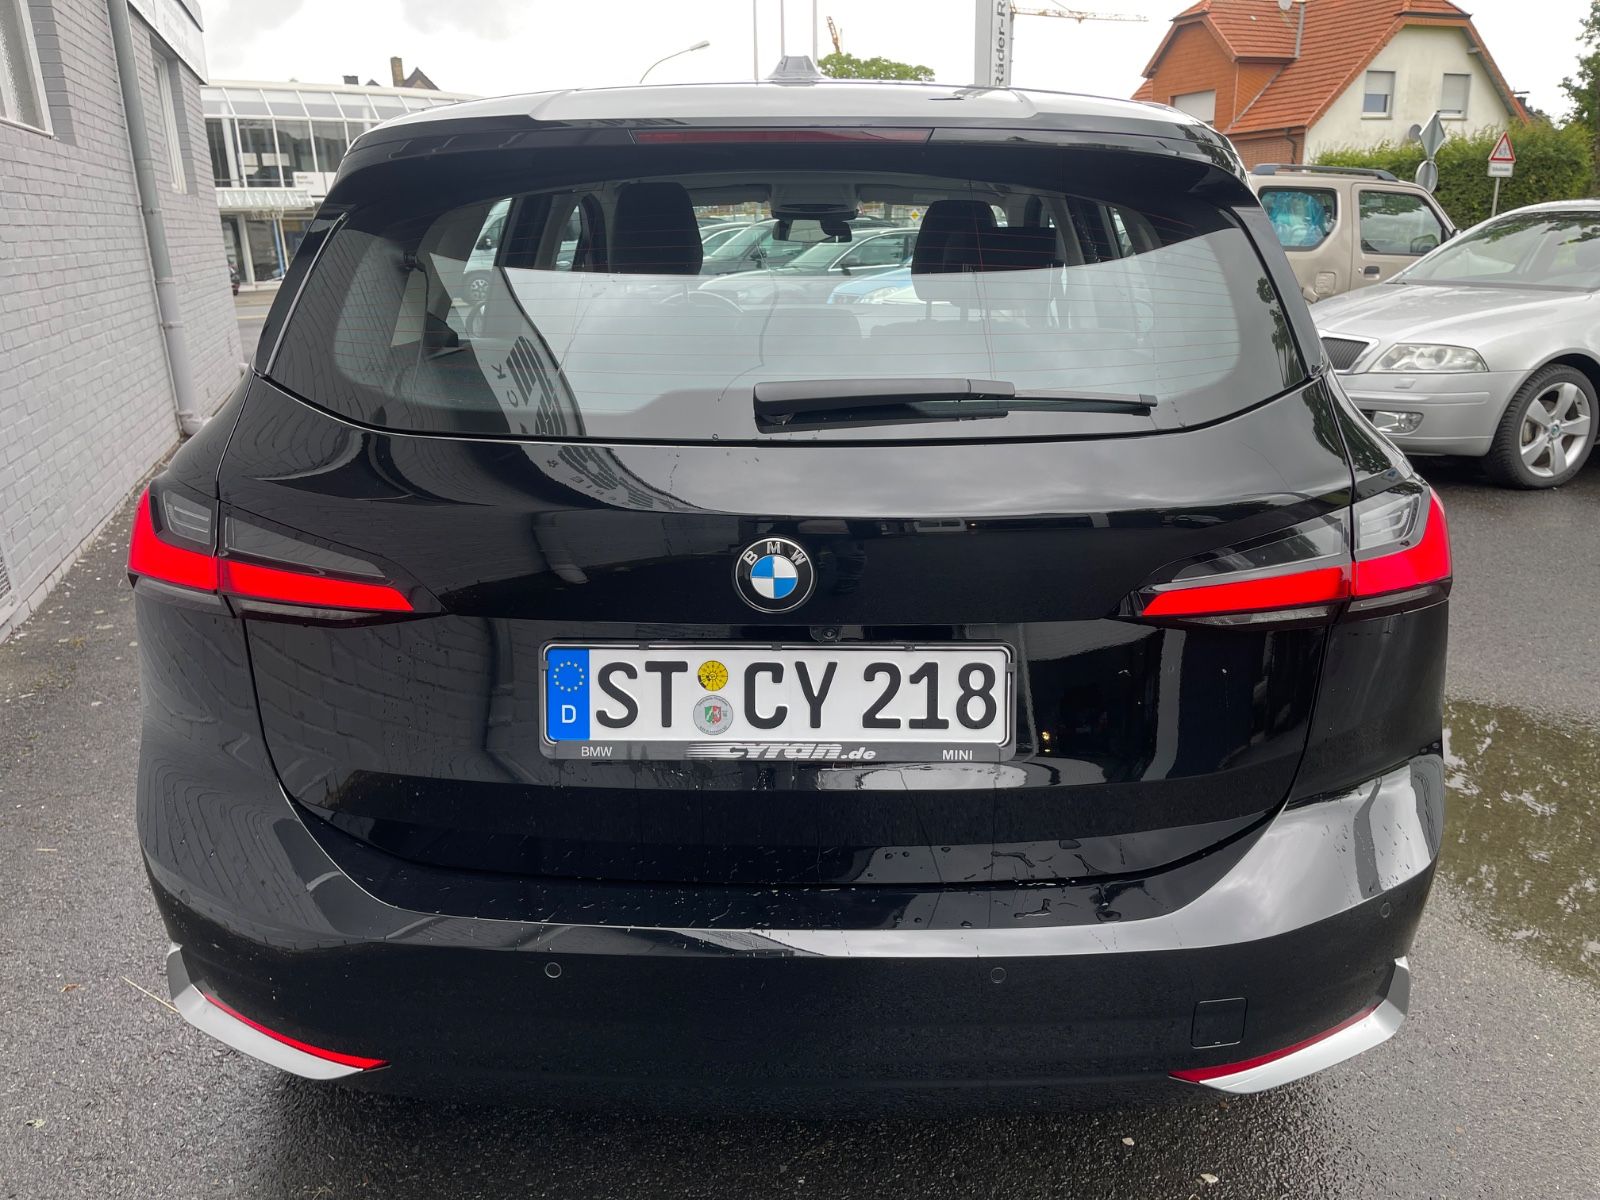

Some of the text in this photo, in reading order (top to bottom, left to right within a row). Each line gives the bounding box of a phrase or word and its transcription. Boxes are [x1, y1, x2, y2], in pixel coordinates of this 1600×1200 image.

[994, 0, 1006, 86] Räder-R
[743, 541, 807, 566] BMW
[596, 660, 689, 729] ST
[743, 661, 839, 730] CY
[862, 661, 997, 730] 218
[561, 704, 577, 724] D
[581, 746, 613, 757] BMW
[942, 749, 973, 761] MINI
